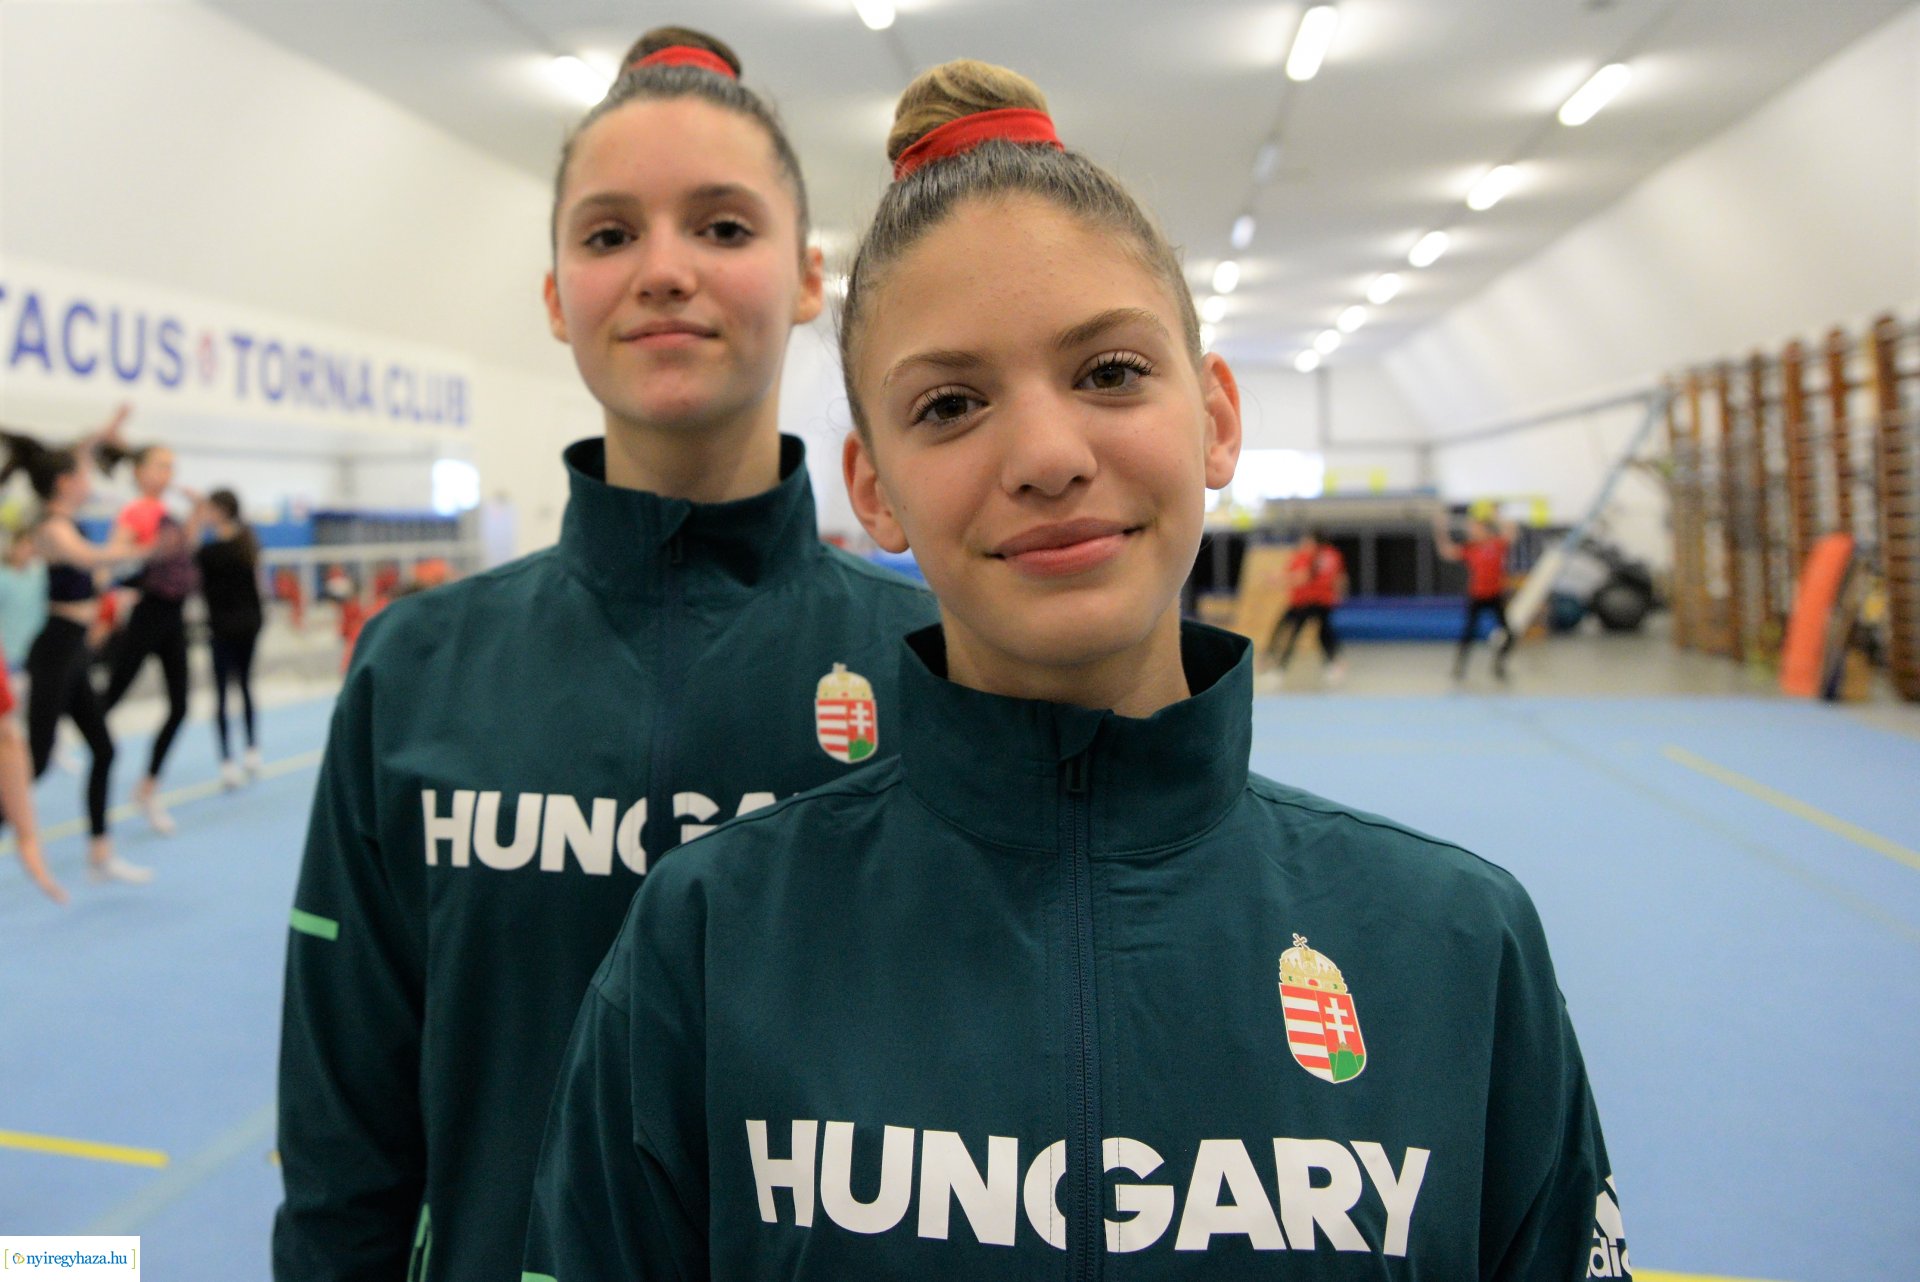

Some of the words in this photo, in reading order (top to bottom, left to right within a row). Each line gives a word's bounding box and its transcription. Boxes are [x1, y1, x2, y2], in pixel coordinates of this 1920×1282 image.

[229, 331, 375, 412] TORNA
[384, 364, 471, 428] CLUB
[421, 789, 799, 876] HUNG
[746, 1118, 1431, 1258] HUNGARY
